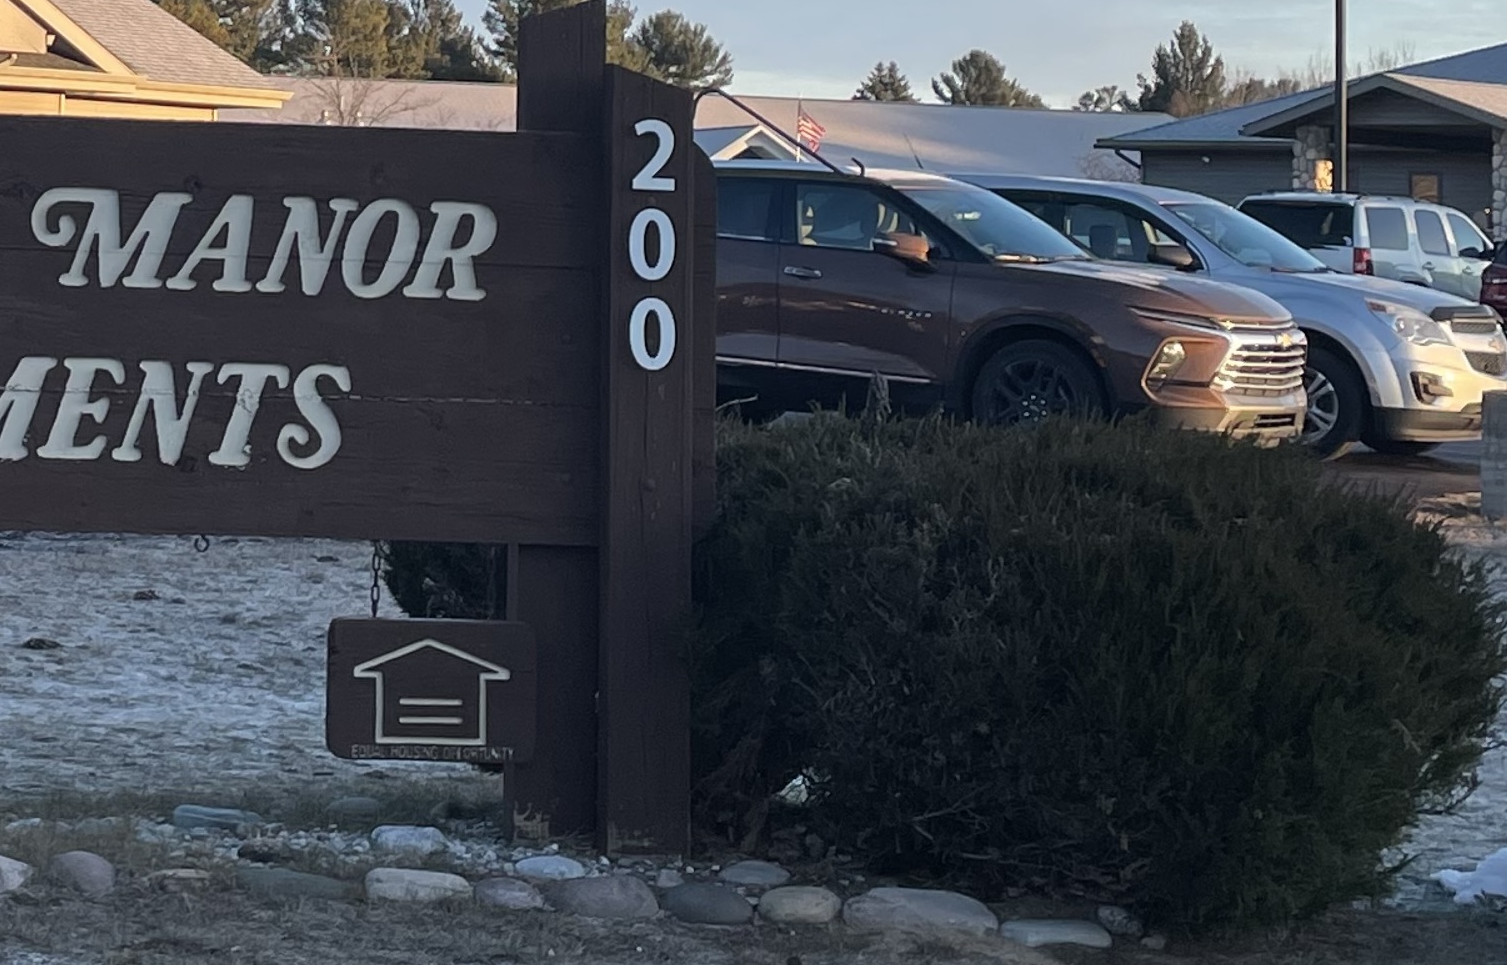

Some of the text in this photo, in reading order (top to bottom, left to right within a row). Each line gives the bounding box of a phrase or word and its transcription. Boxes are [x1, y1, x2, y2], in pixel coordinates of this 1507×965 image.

[31, 187, 497, 301] MANOR
[628, 119, 676, 371] 200
[351, 743, 385, 759] EQUAL
